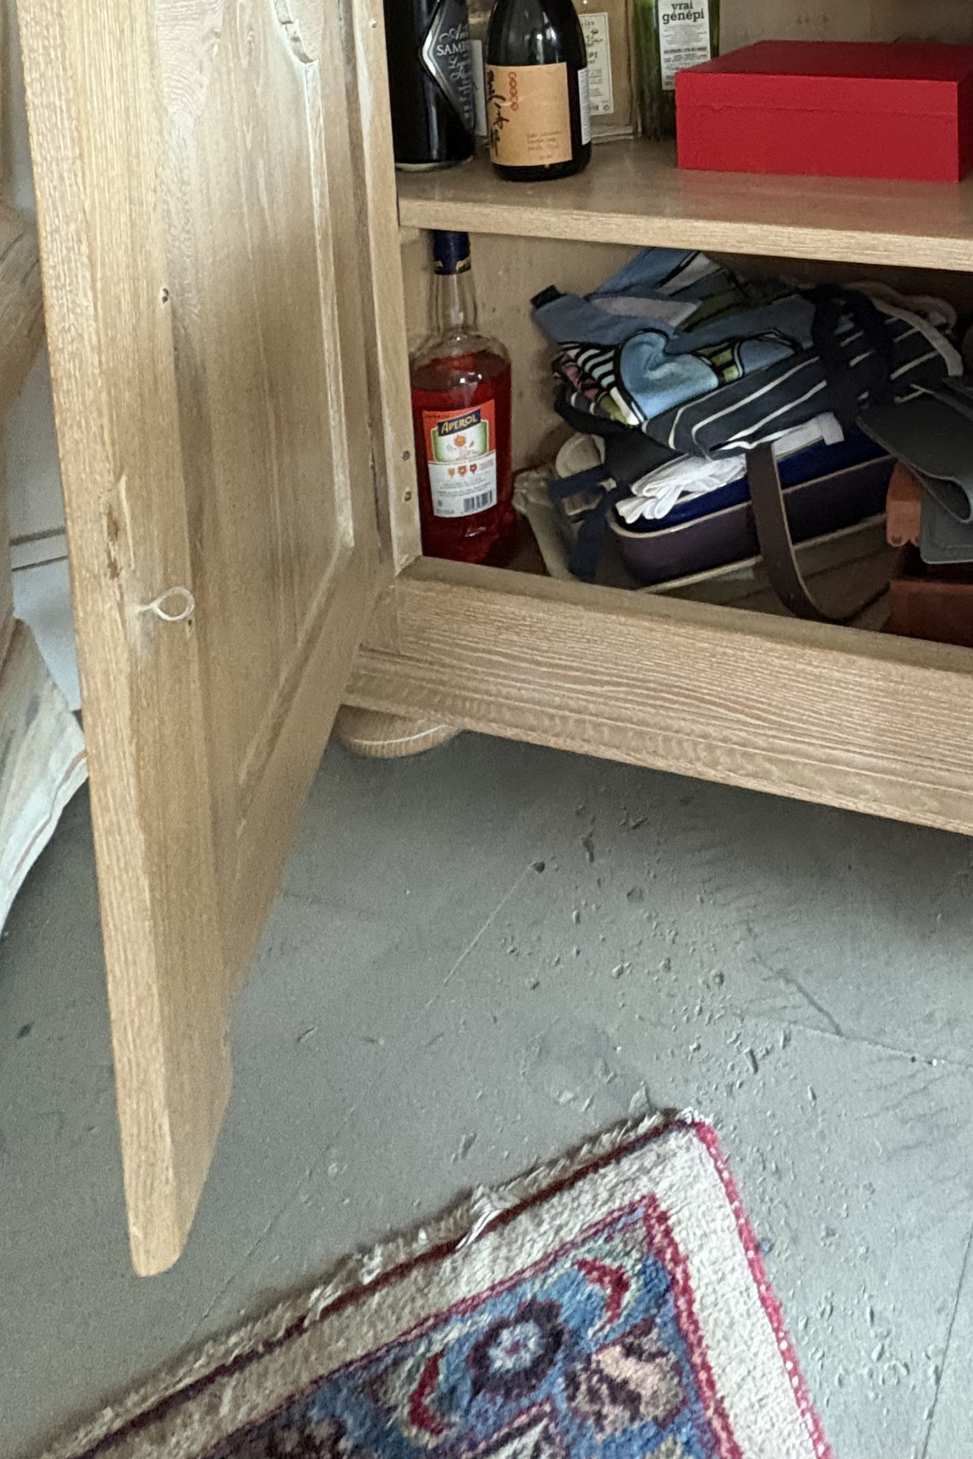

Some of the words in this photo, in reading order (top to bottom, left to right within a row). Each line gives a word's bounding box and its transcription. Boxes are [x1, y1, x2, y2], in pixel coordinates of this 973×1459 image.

[671, 0, 693, 10] vrai
[662, 8, 705, 25] génépi
[441, 414, 478, 434] APEROL
